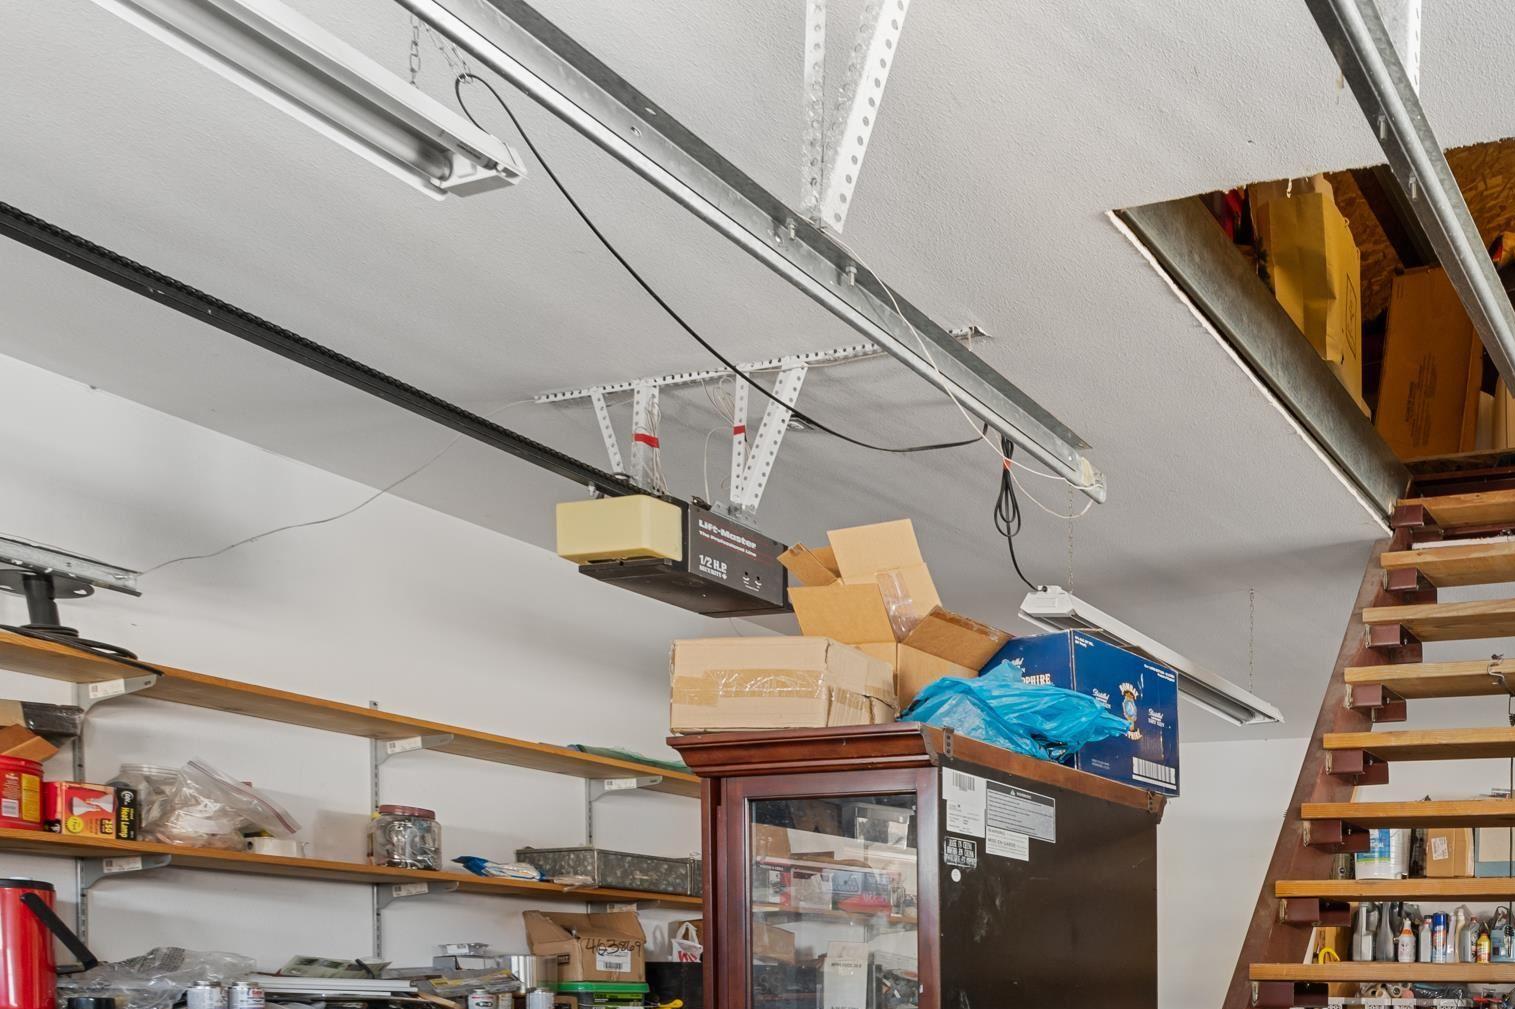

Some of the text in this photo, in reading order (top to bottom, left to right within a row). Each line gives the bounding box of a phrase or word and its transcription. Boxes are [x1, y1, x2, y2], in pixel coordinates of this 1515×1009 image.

[699, 519, 757, 549] Lift-Master
[121, 807, 130, 822] Heat
[118, 822, 130, 838] Lamp
